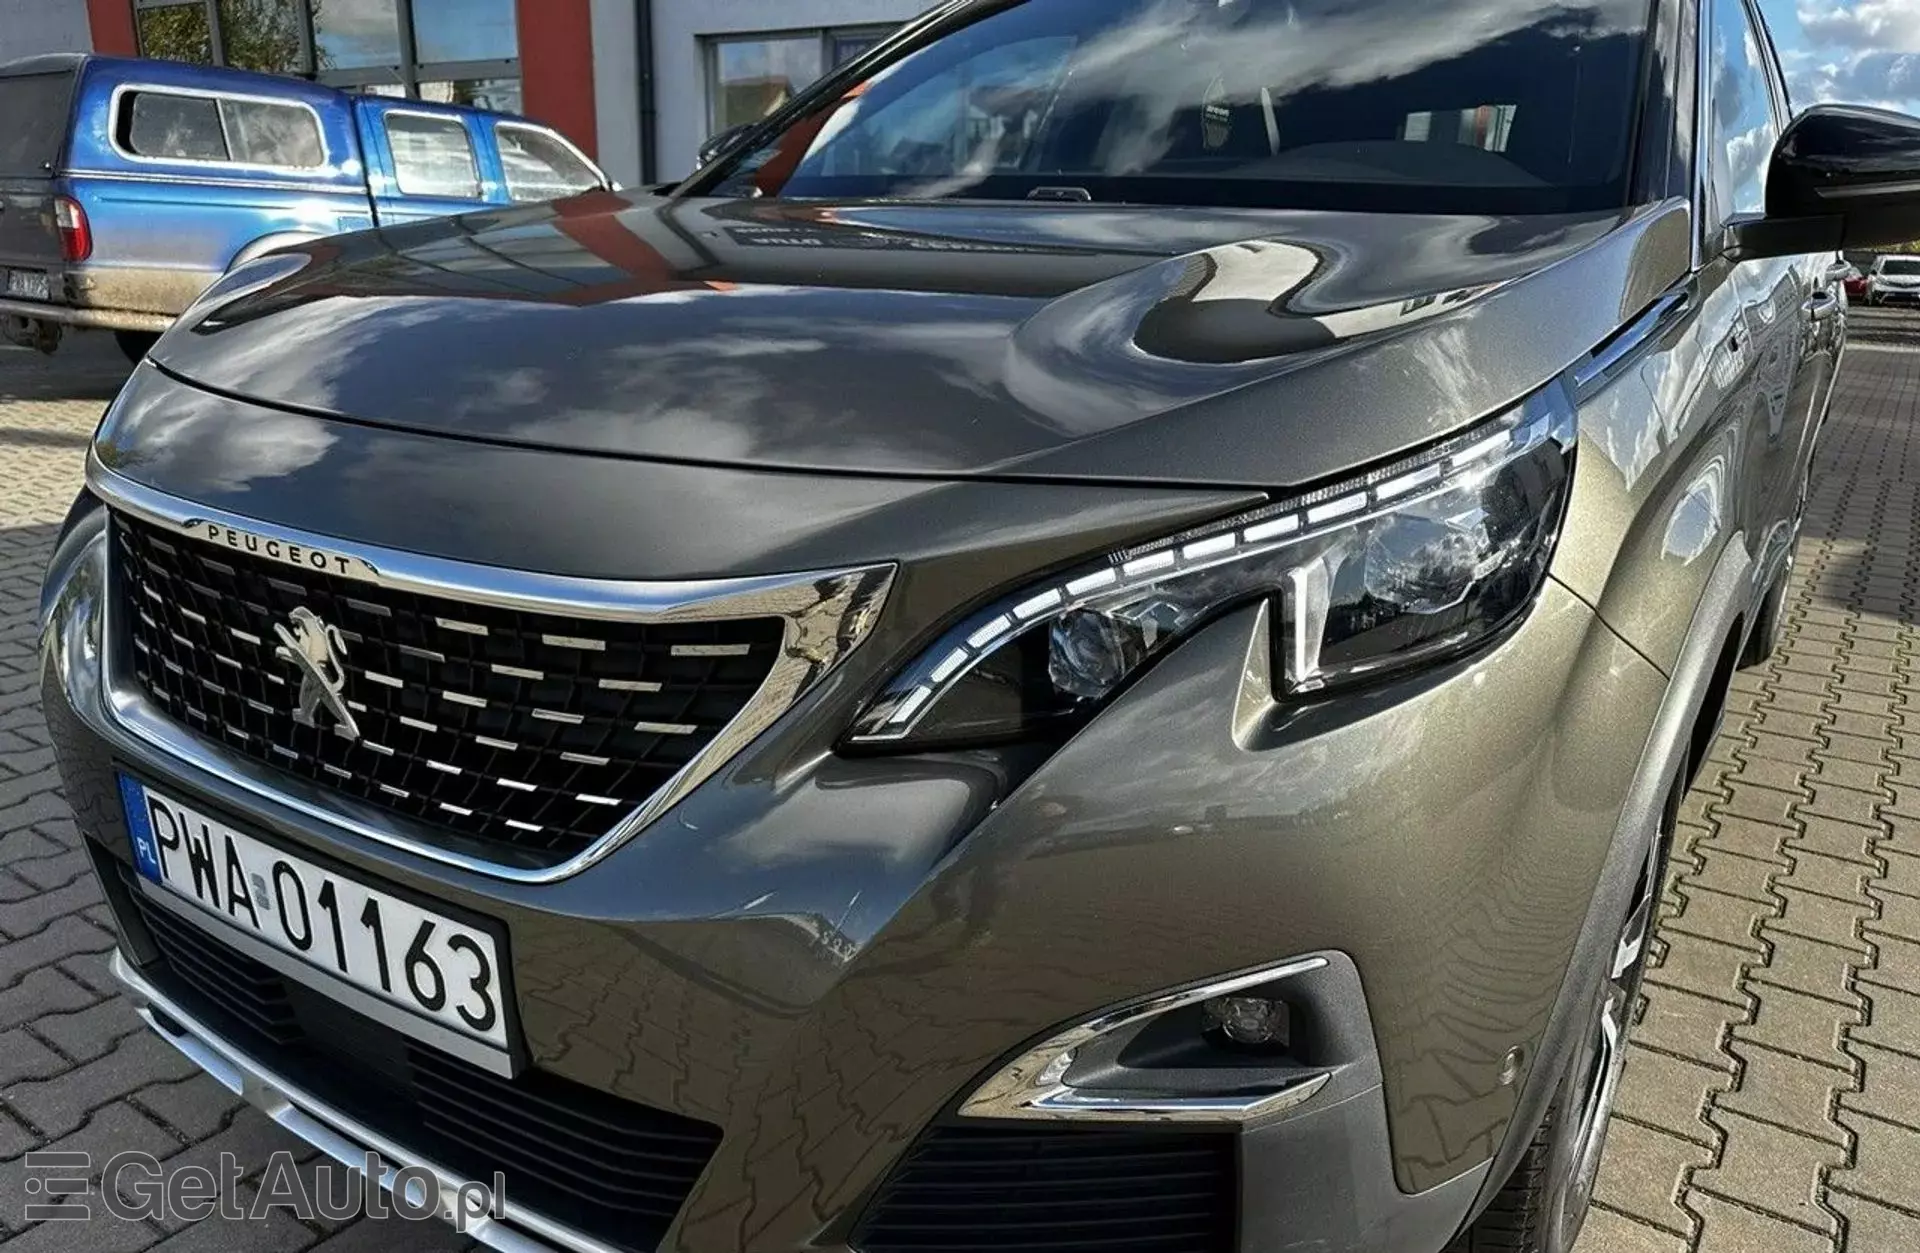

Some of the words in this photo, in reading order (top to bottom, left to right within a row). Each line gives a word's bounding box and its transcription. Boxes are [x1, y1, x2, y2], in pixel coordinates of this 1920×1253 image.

[208, 524, 350, 574] PEUGEOT
[136, 836, 157, 865] PL
[147, 795, 261, 930] PWA
[271, 859, 497, 1032] 01163
